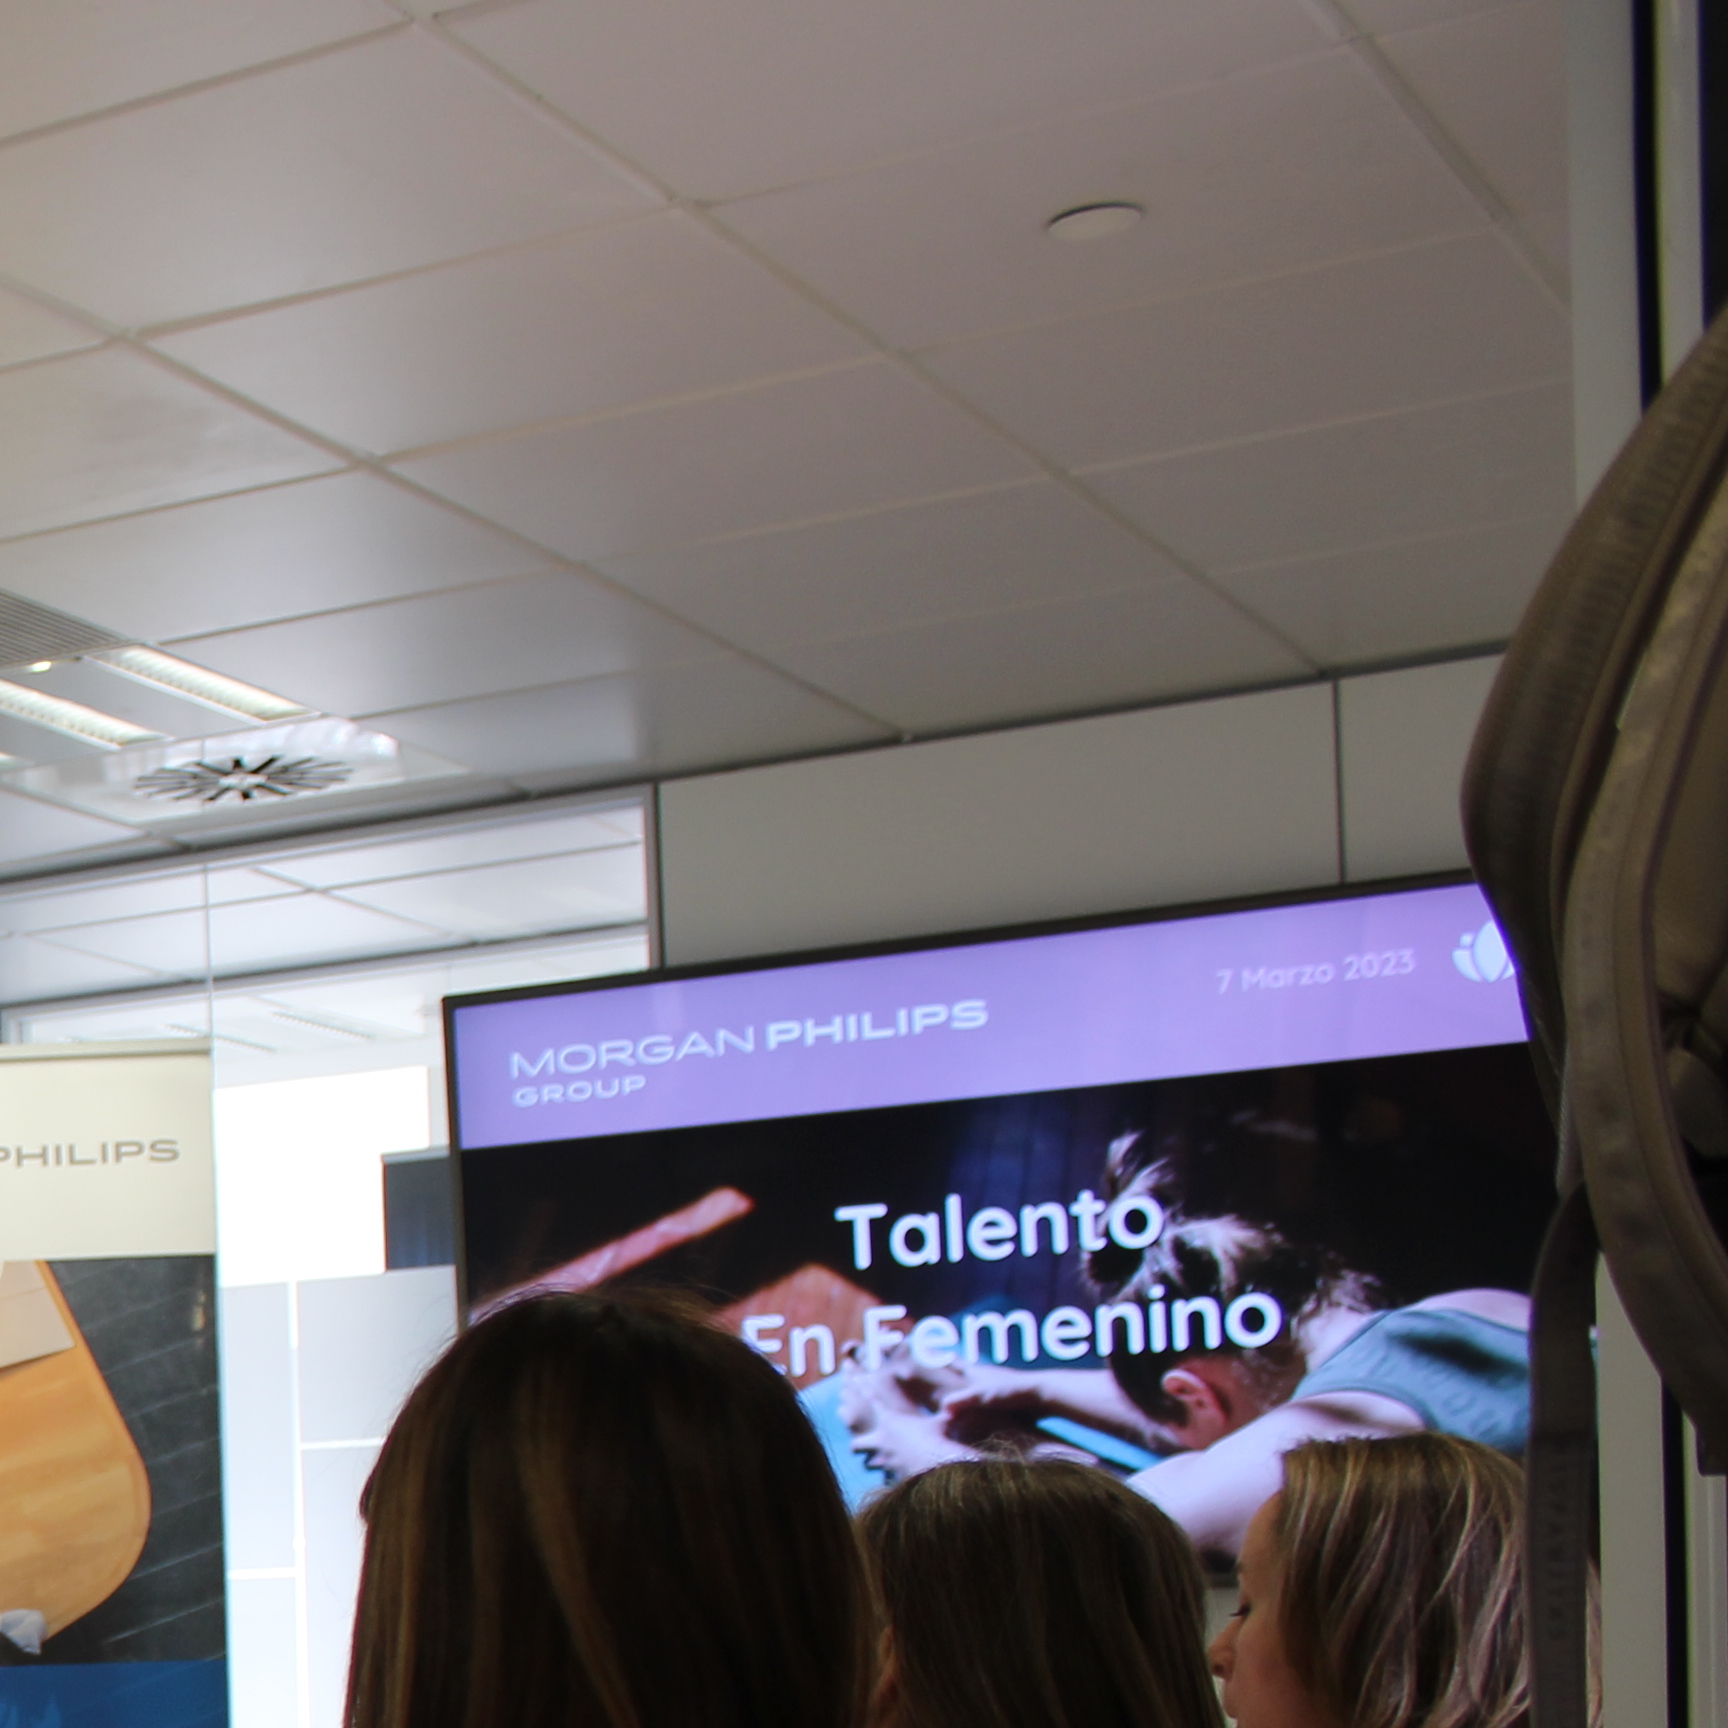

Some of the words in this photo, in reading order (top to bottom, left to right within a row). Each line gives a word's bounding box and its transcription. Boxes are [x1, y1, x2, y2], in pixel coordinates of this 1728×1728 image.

[1215, 968, 1234, 995] 7
[1241, 961, 1336, 991] Marzo
[1344, 948, 1416, 982] 2023
[508, 1025, 756, 1080] MORGAN
[764, 998, 989, 1052] PHILIPS
[512, 1074, 647, 1108] GROUP
[834, 1188, 1165, 1271] Talento
[741, 1313, 836, 1378] En
[862, 1283, 1283, 1370] Femenino
